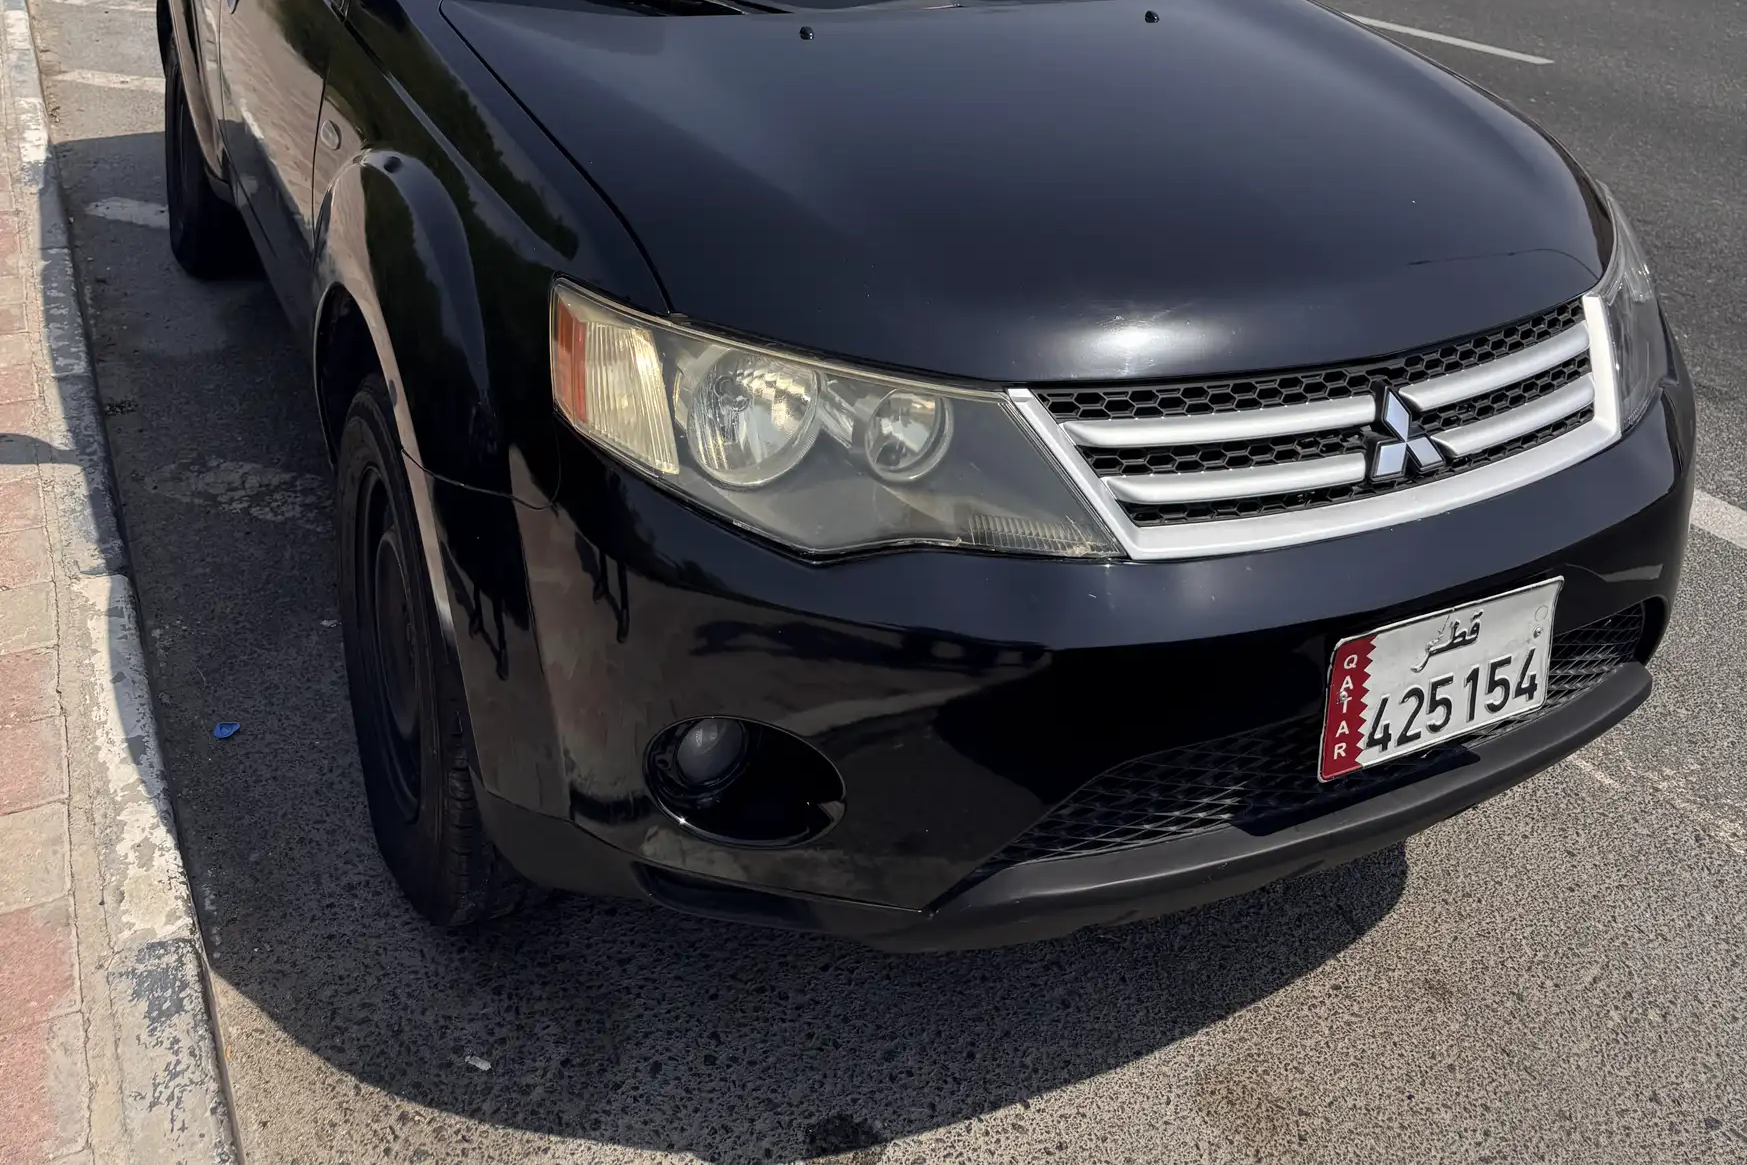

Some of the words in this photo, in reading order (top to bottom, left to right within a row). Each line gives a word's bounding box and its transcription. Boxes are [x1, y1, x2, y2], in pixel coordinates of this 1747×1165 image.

[1410, 609, 1484, 673] قطر
[1333, 653, 1358, 761] QATAR
[1364, 645, 1539, 754] 425154
